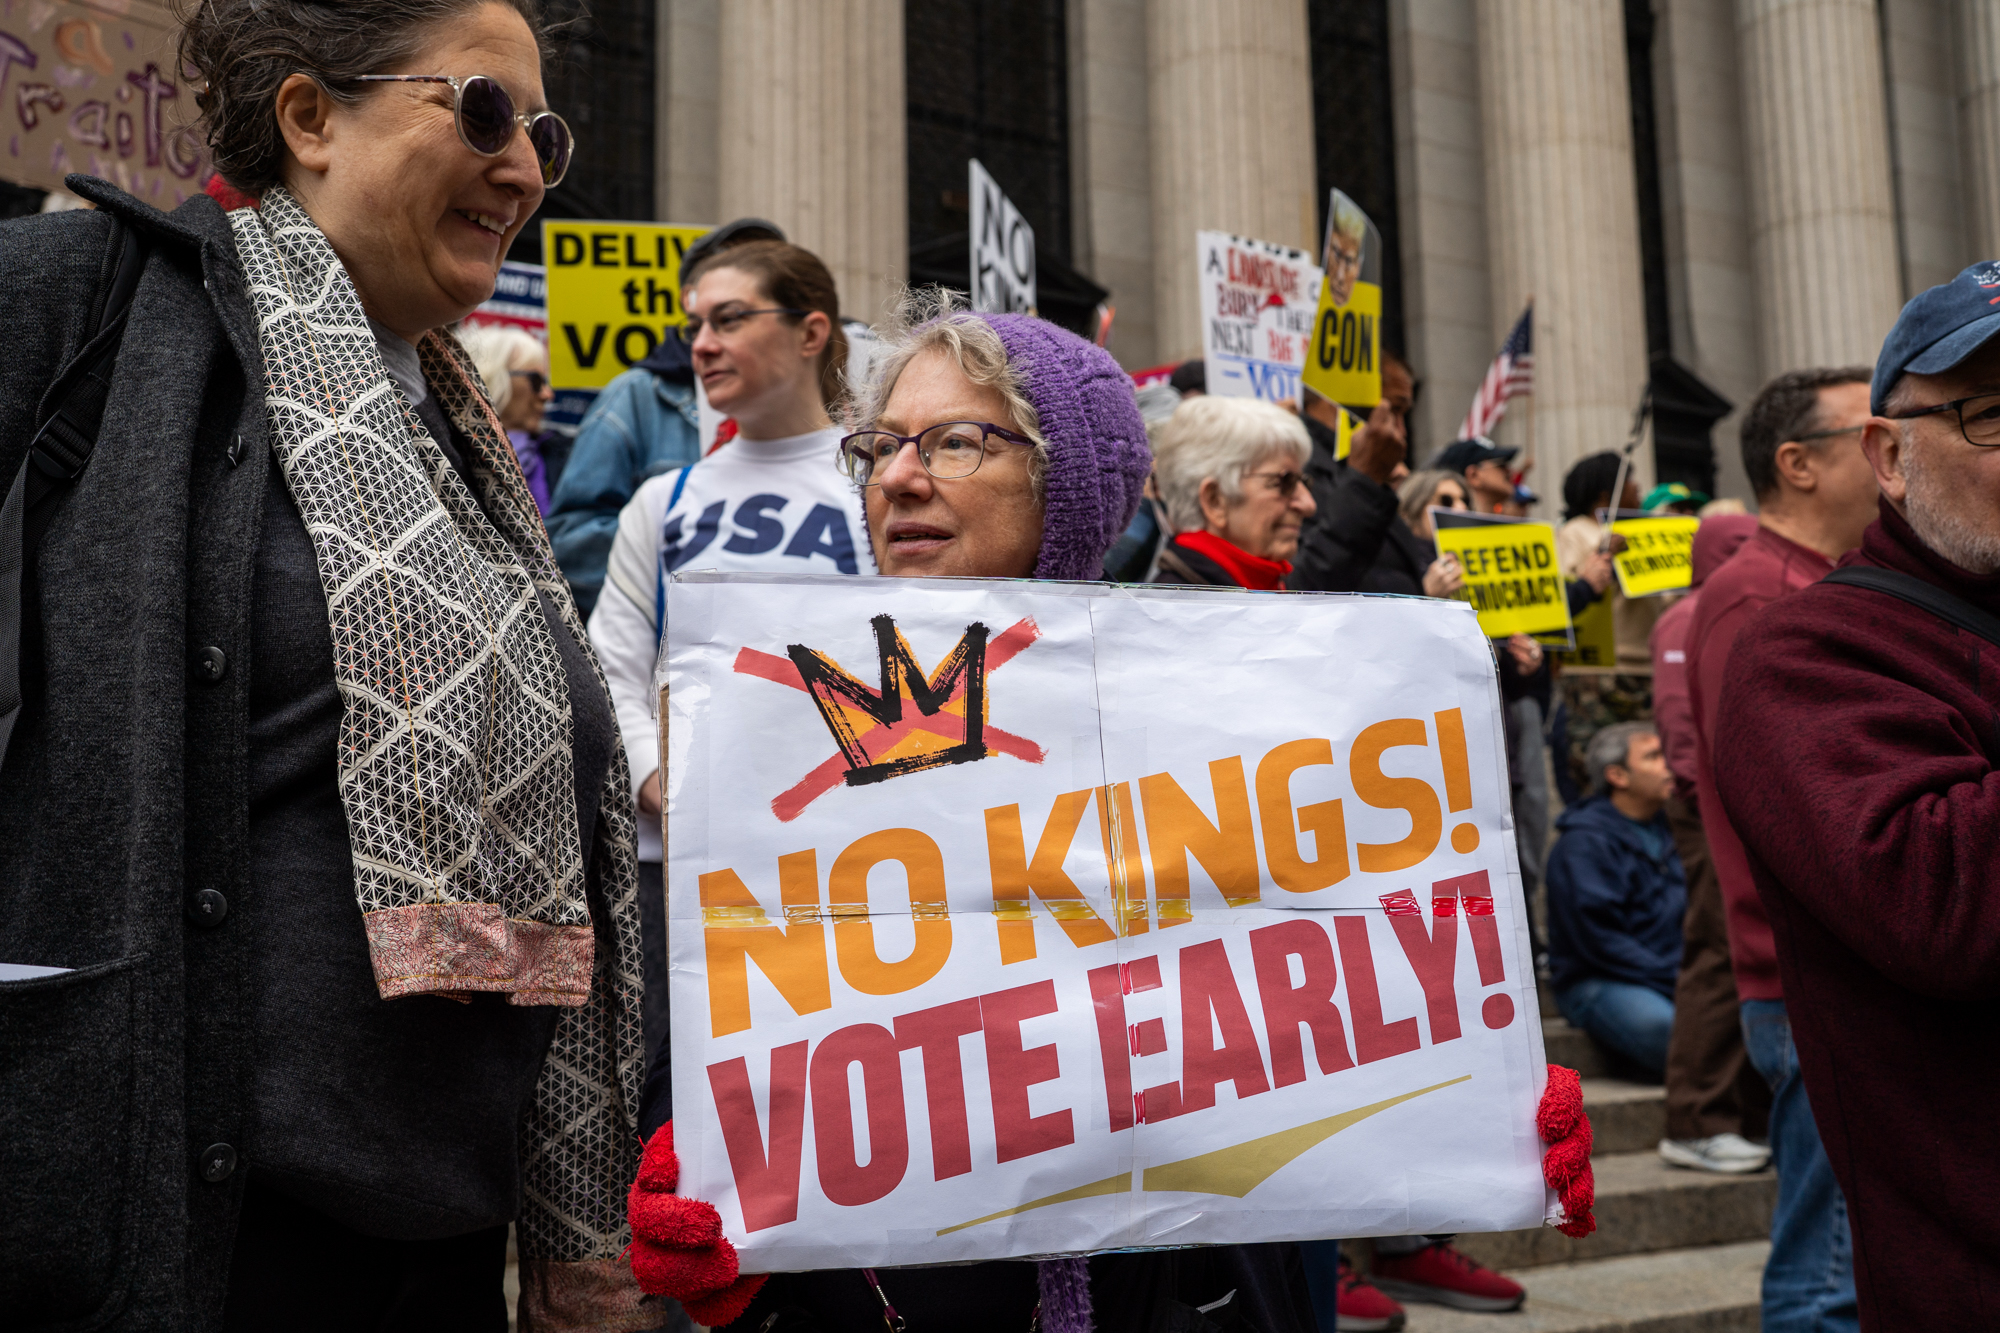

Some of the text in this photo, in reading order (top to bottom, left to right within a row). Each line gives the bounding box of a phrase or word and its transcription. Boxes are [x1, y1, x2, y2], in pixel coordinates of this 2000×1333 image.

[0, 30, 206, 182] Traito
[553, 232, 697, 269] DELIV
[981, 182, 1032, 287] NO
[621, 277, 682, 316] th
[562, 321, 661, 369] VO
[1319, 308, 1373, 372] CON
[1246, 361, 1301, 402] VOT
[663, 493, 860, 574] USA
[698, 707, 1480, 1039] NO KINGS!
[706, 869, 1515, 1233] VOTE EARLY!
